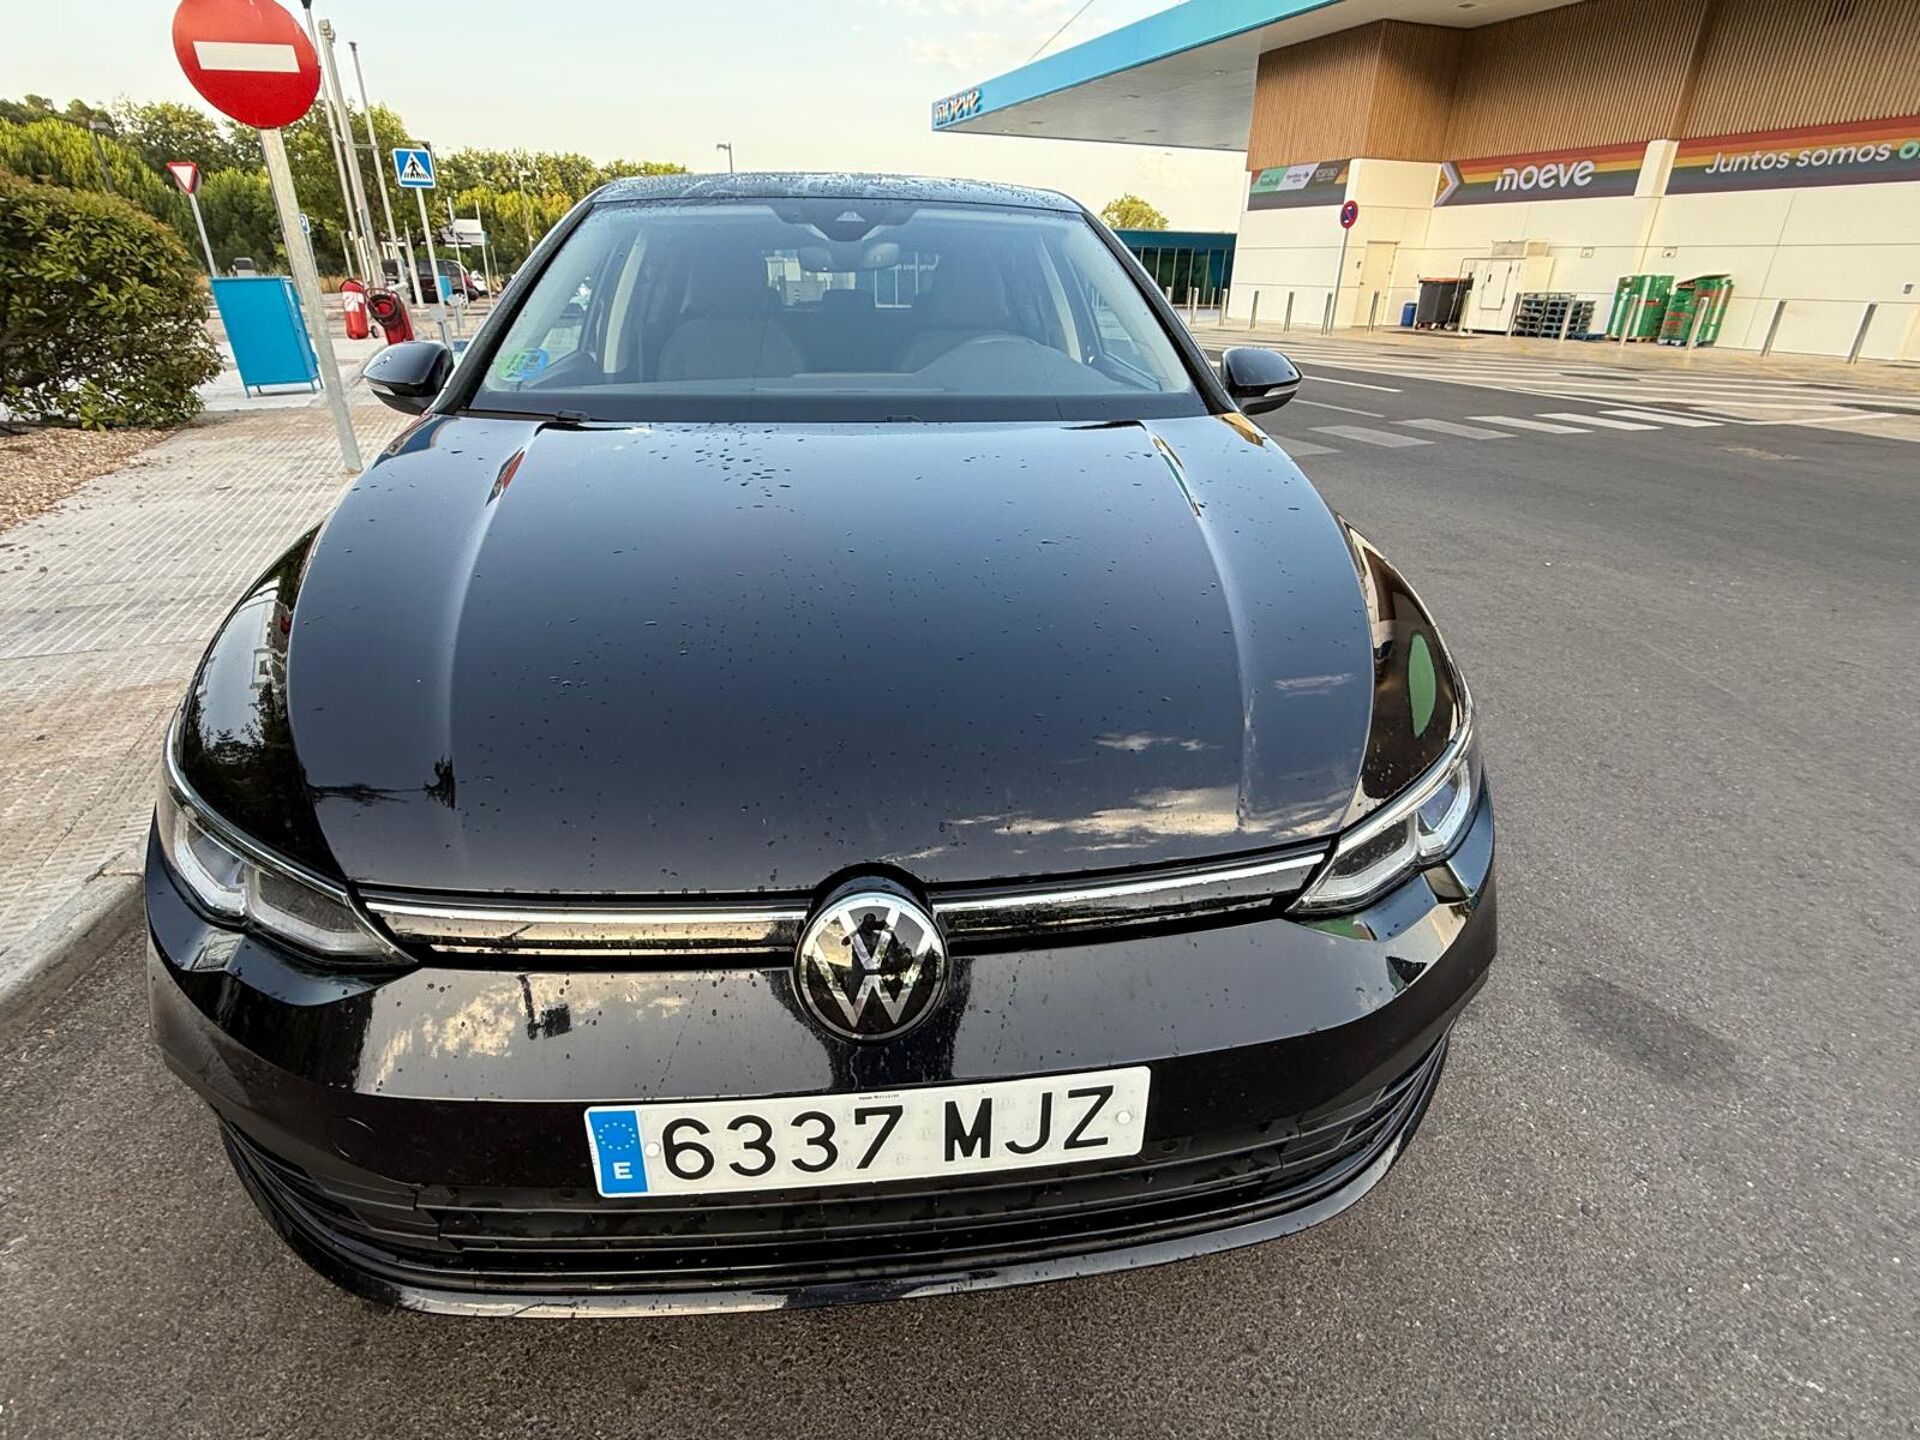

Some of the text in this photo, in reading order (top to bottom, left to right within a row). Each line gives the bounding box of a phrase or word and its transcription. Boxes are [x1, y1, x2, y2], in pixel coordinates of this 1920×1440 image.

[1705, 141, 1920, 174] Juntos somos o
[1495, 160, 1595, 192] moeve
[661, 1084, 1115, 1181] 6337 MJZ
[612, 1161, 633, 1180] E
